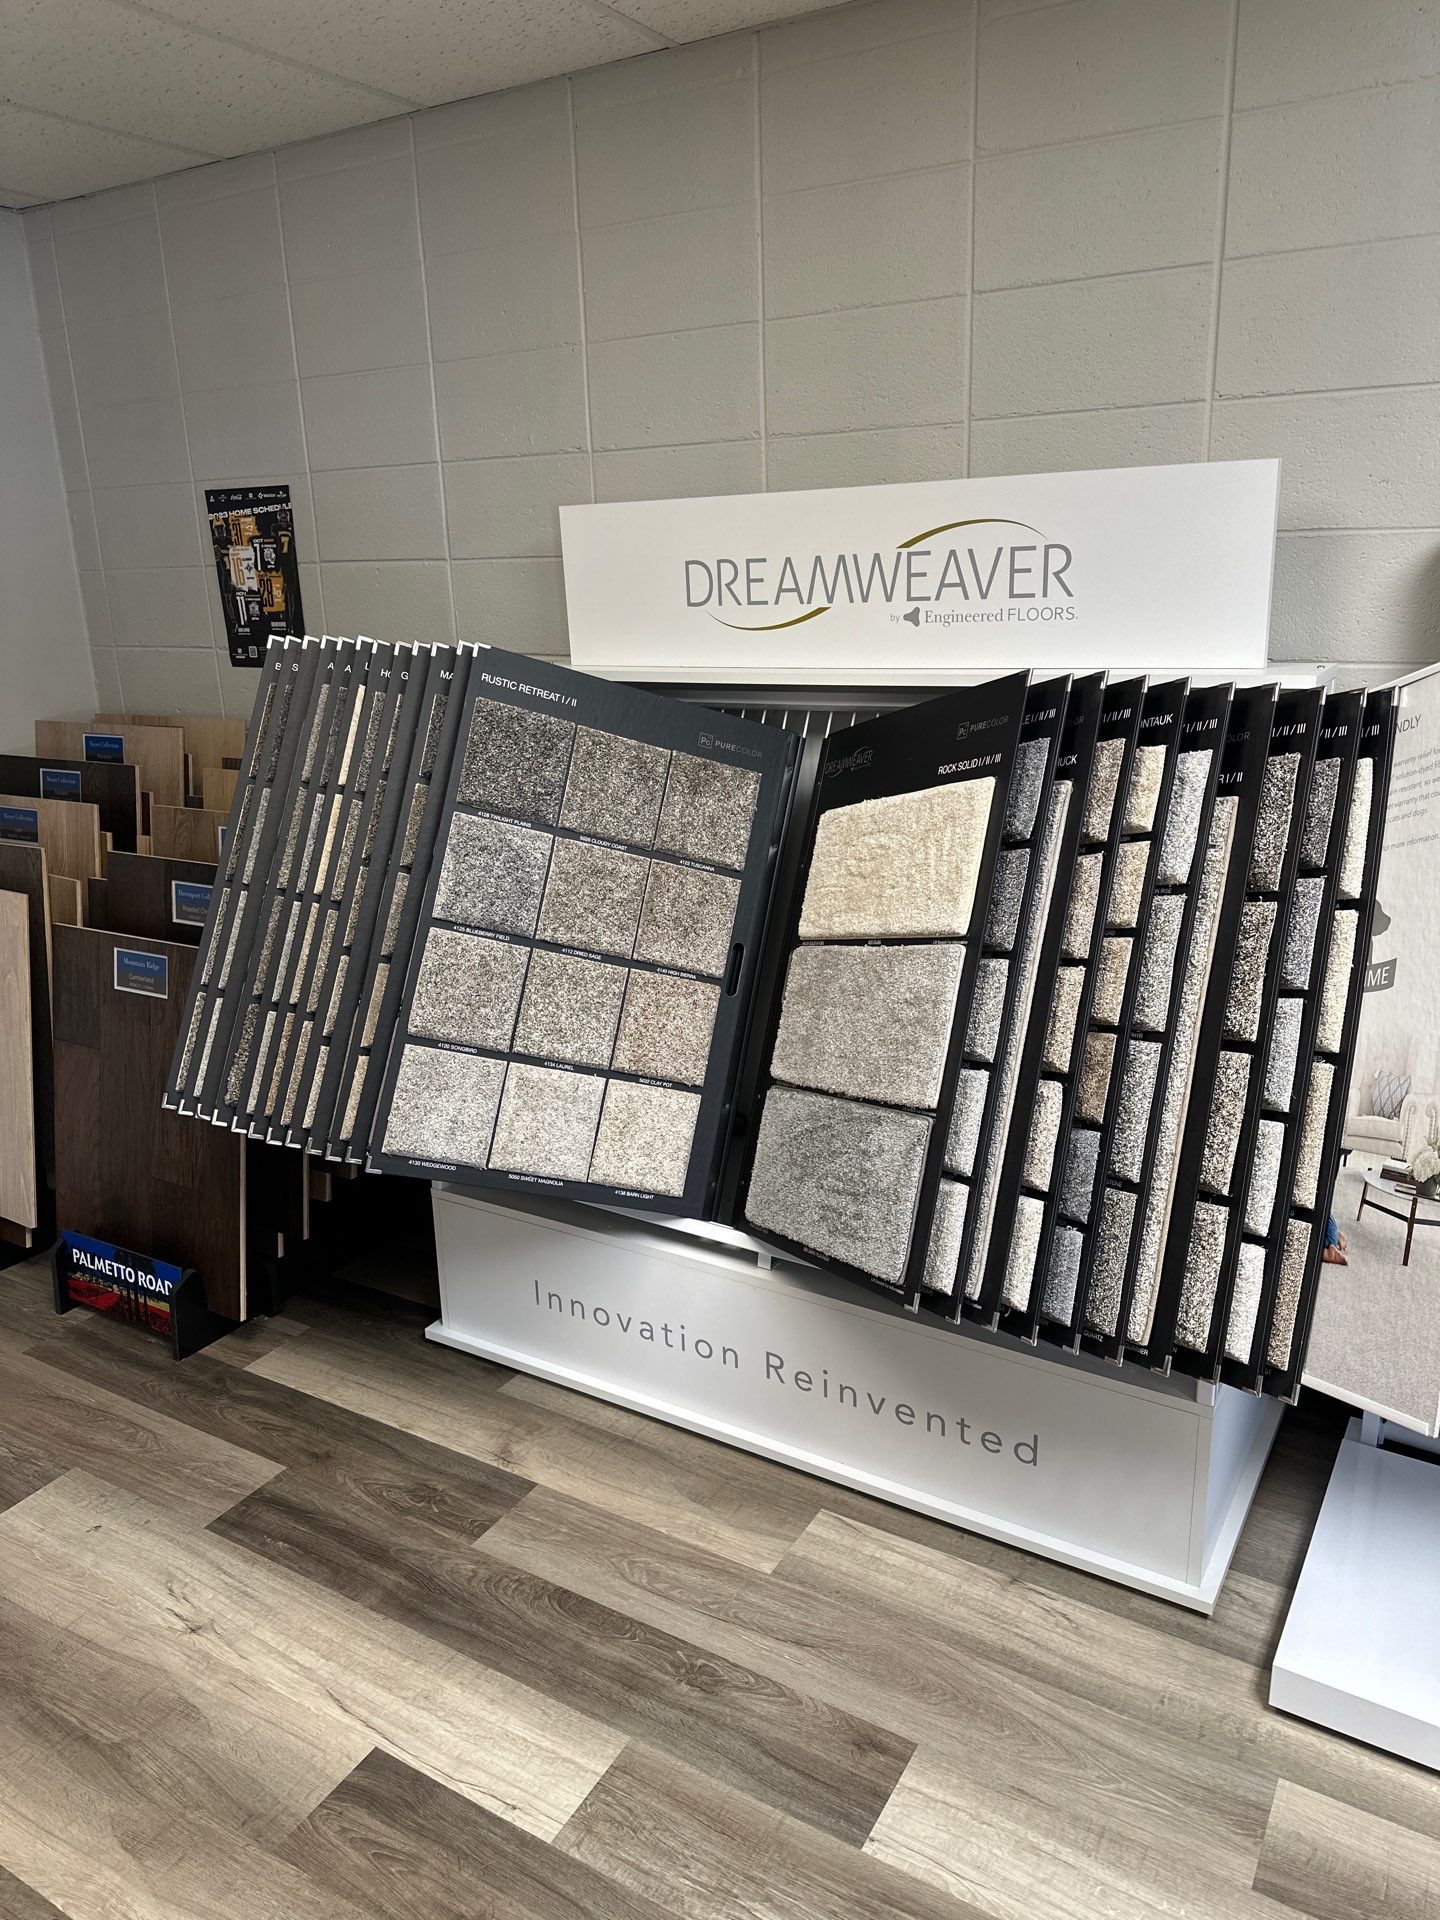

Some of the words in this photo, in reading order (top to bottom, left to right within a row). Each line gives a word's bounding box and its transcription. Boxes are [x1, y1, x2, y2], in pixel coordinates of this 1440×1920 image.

[229, 508, 252, 516] HOME
[684, 543, 1074, 607] DREAMWEAVER
[259, 578, 274, 608] 28
[890, 612, 900, 624] by
[924, 608, 1004, 627] Engineered
[481, 673, 517, 690] RUSTIC
[518, 683, 560, 702] RETREAT
[970, 716, 1009, 732] PURECOLOR
[714, 740, 763, 759] PURECOLOR
[824, 750, 873, 775] DREAMWEAVER
[1394, 756, 1416, 768] warranty
[1417, 749, 1432, 760] relief
[937, 761, 957, 776] ROCK
[957, 757, 978, 774] SOLID
[1394, 797, 1418, 808] warranty
[1419, 792, 1430, 801] that
[489, 813, 513, 823] TWILIGHT
[513, 819, 532, 828] PLAINS
[1401, 811, 1412, 820] and
[590, 838, 611, 847] CLOUDY
[610, 842, 627, 851] COAST
[1391, 841, 1405, 849] more
[465, 927, 495, 938] BLUEBERRY
[495, 933, 510, 941] FIELD
[123, 957, 145, 968] Mountain
[147, 961, 160, 972] Ridge
[679, 971, 697, 980] SIERRA
[450, 1044, 477, 1054] SONGBIRD
[555, 1062, 574, 1070] LAUREL
[421, 1161, 456, 1171] WEDGEWOOD
[520, 1175, 537, 1183] SWEET
[537, 1177, 564, 1187] MAGNOLIA
[72, 1248, 135, 1283] PALMETTO
[1084, 1330, 1104, 1342] QUARTZ
[534, 1279, 740, 1370] Innovation
[765, 1351, 1040, 1467] Reinvented
